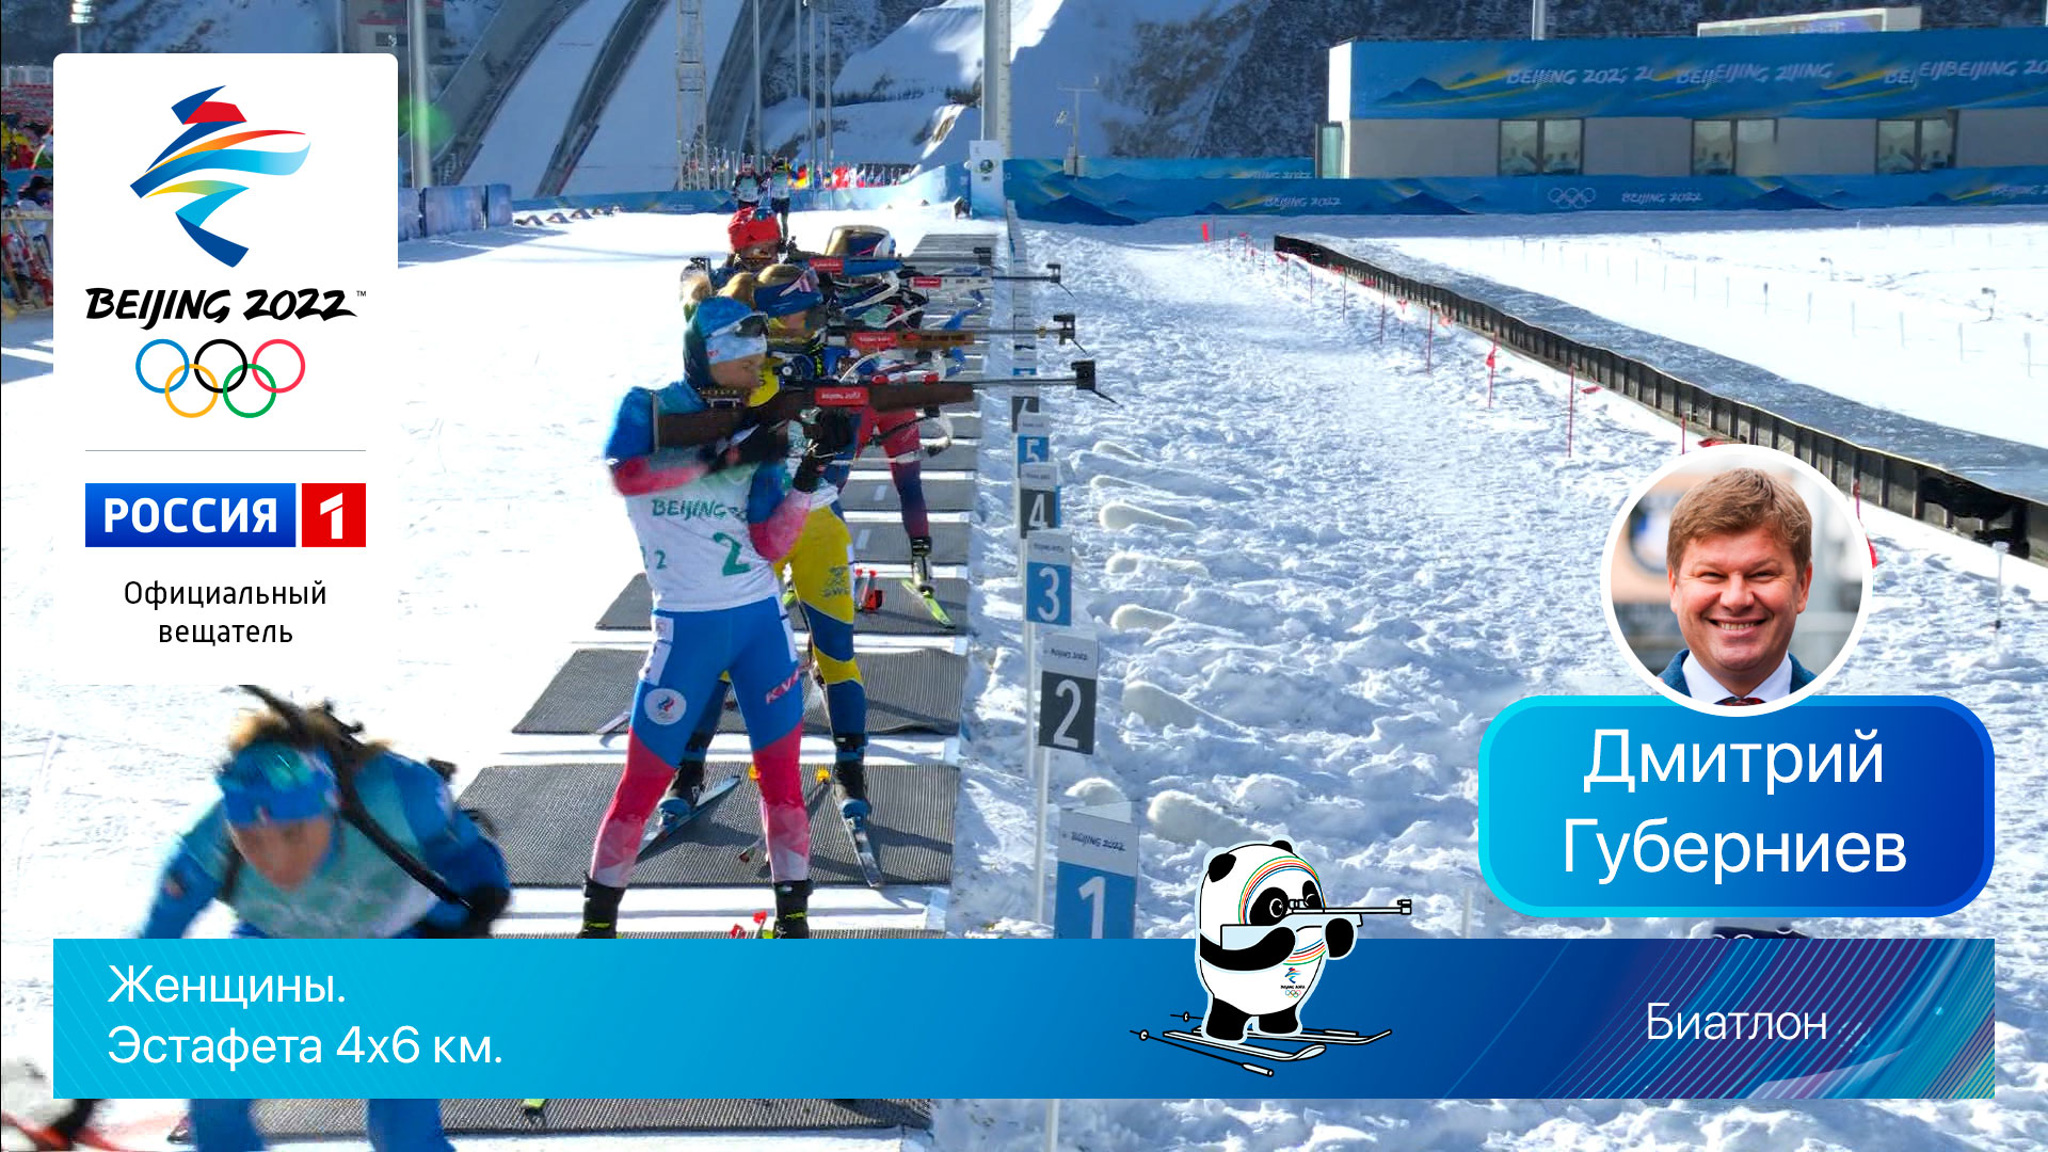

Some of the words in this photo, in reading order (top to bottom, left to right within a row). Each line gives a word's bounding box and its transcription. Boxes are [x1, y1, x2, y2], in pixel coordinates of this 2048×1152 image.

[652, 499, 727, 521] BEIJING
[1028, 493, 1049, 530] 4
[654, 550, 667, 570] 2
[713, 531, 752, 577] 2
[1037, 565, 1061, 622] 3
[1053, 679, 1081, 749] 2
[1079, 876, 1106, 939] 1
